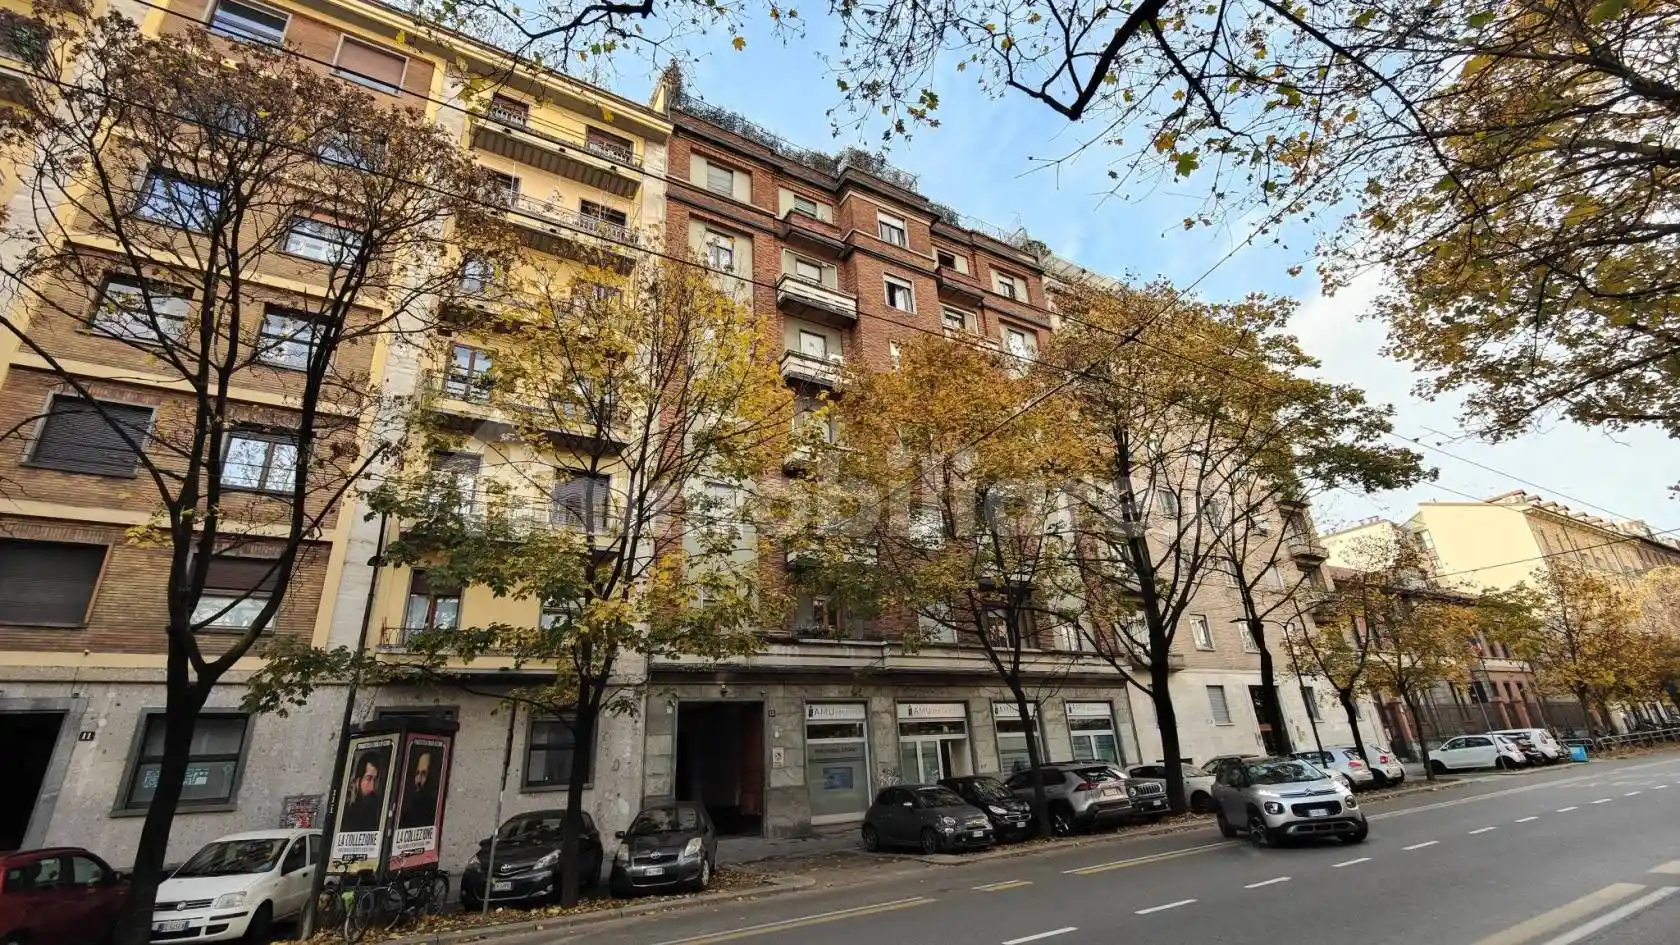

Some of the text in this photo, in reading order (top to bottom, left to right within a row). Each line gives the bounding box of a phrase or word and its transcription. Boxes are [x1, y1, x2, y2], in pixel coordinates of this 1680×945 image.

[814, 707, 835, 716] AMU
[345, 832, 379, 846] COLLEZIONE
[403, 827, 434, 843] COLLEZIONE
